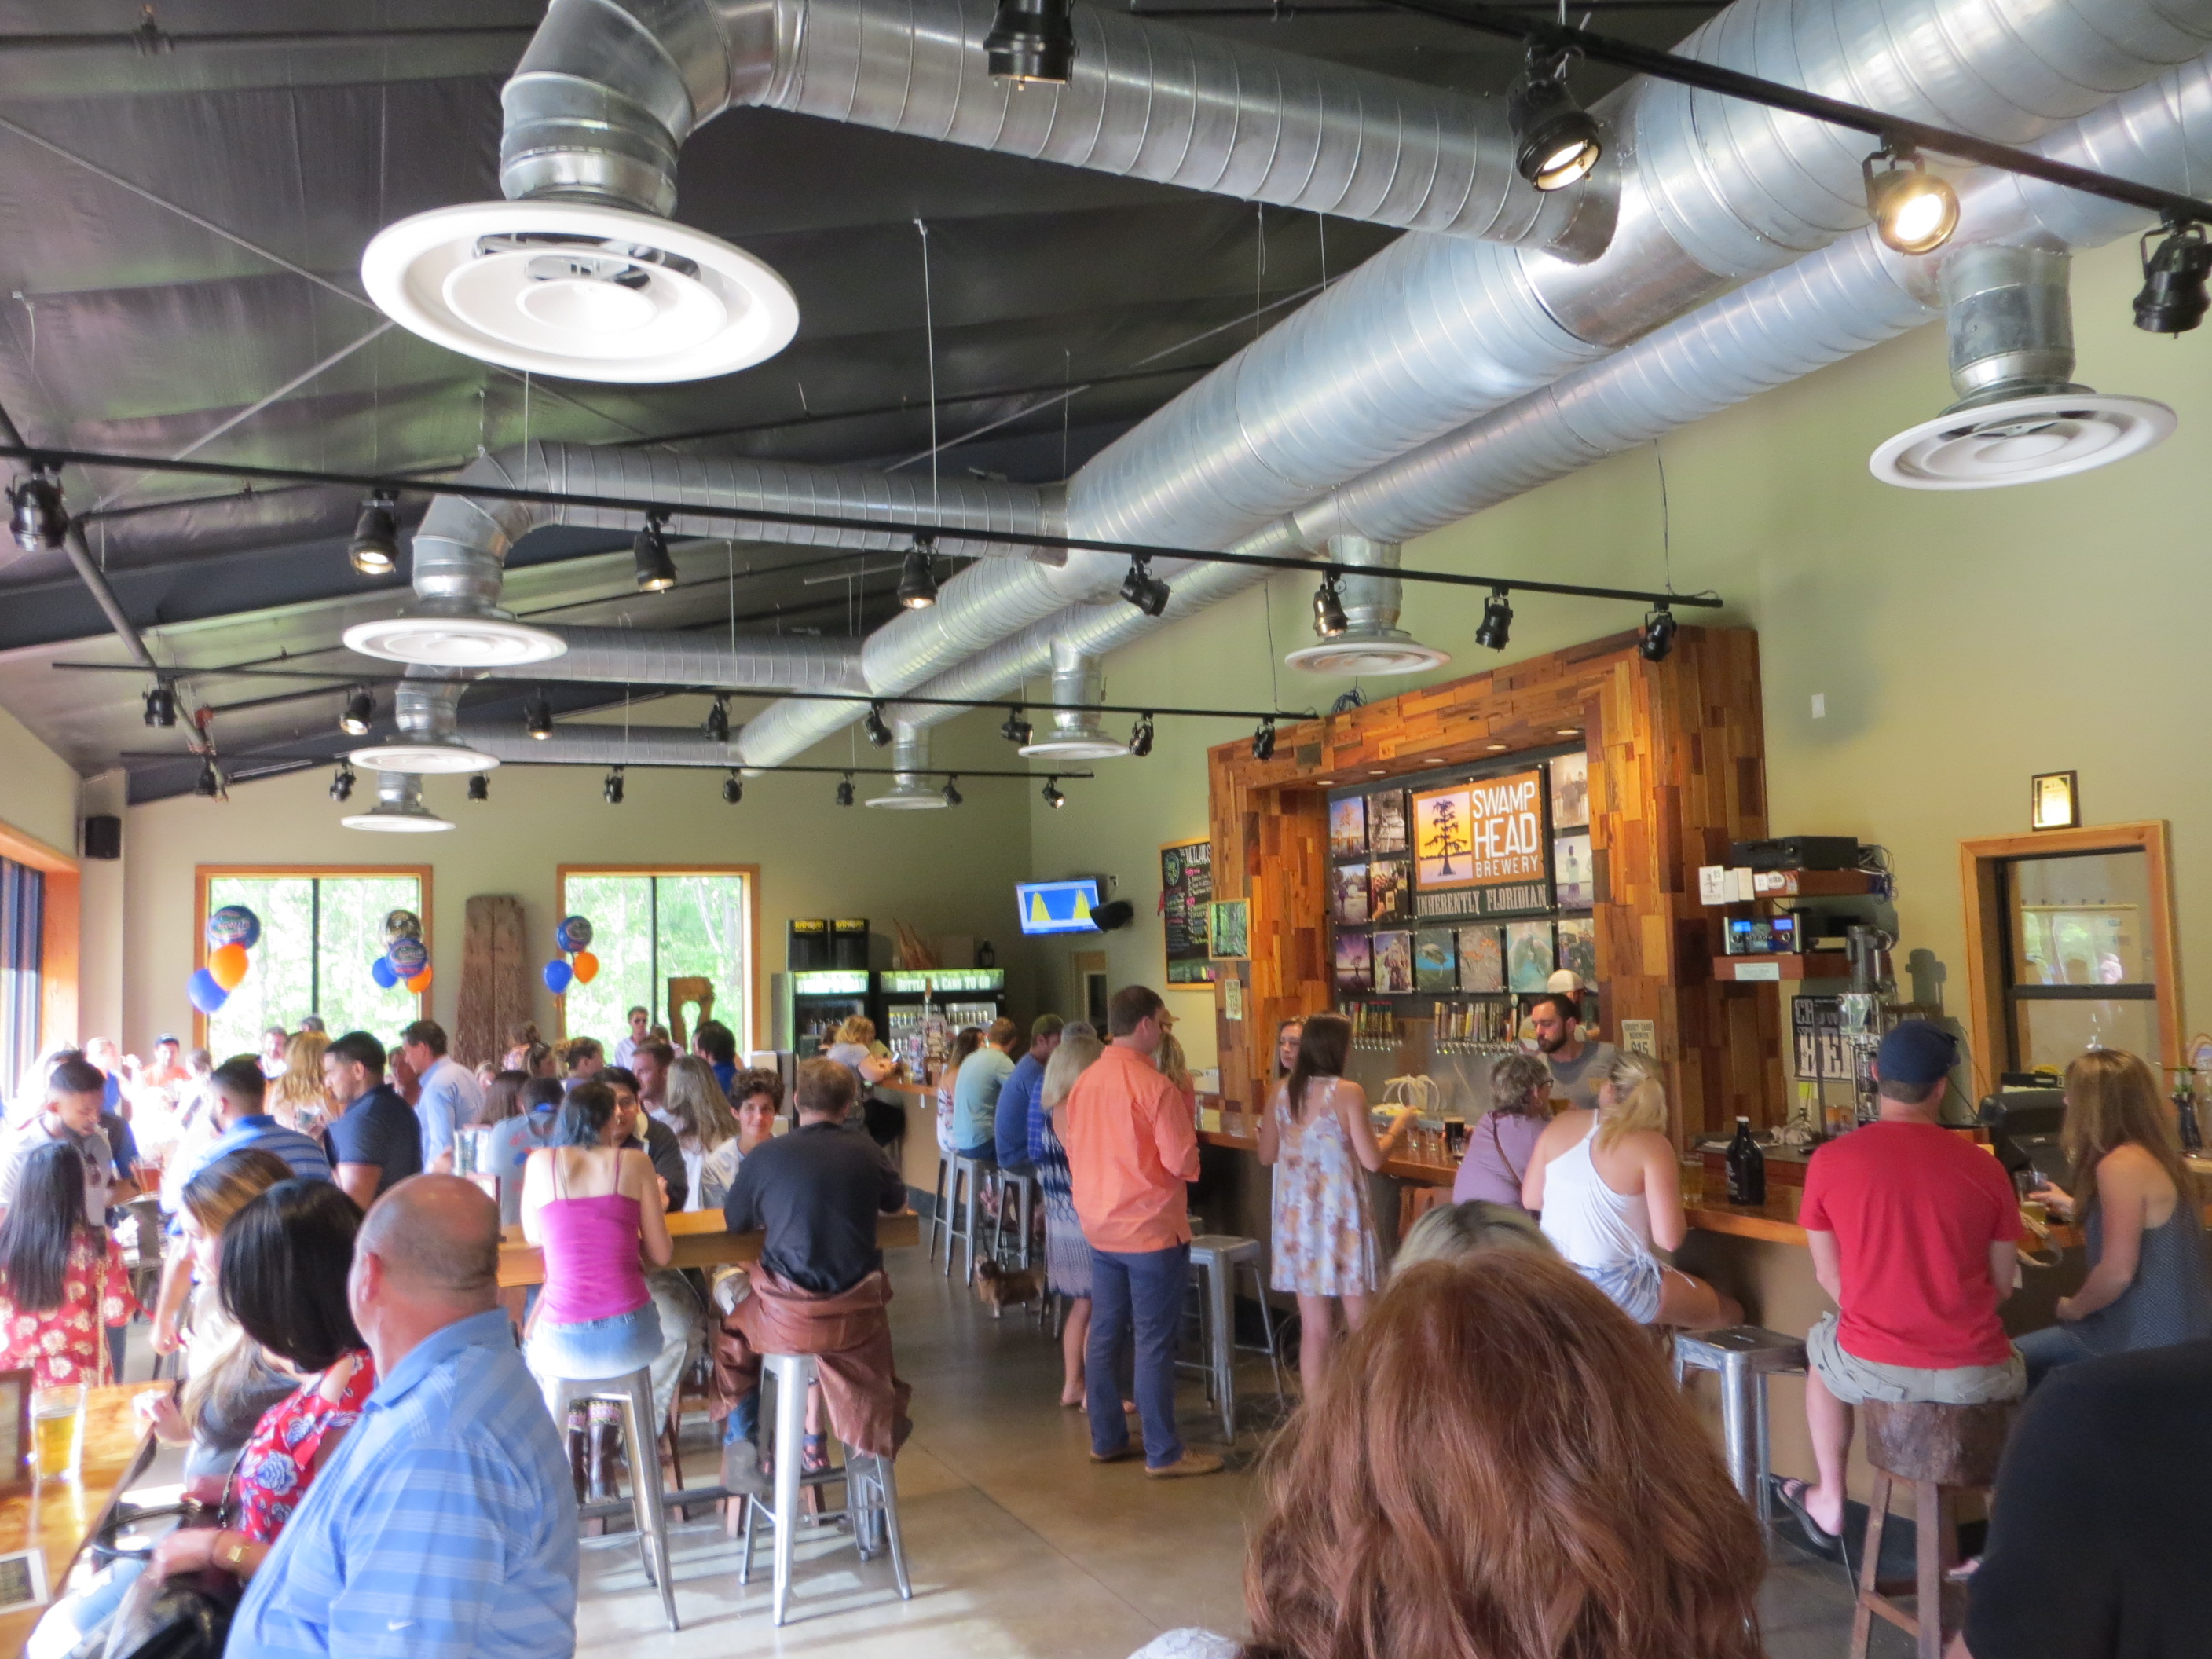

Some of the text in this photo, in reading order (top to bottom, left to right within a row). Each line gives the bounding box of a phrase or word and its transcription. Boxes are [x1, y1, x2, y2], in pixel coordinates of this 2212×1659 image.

[1472, 780, 1536, 819] SWAMP
[1474, 811, 1537, 861] HEAD
[1475, 854, 1539, 878] BREWERY
[1416, 884, 1547, 917] INHERENTLY FLORIDIAN
[896, 978, 930, 991] BOTTLE
[942, 976, 962, 991] CANS
[965, 976, 976, 990] TO
[980, 975, 991, 989] GO
